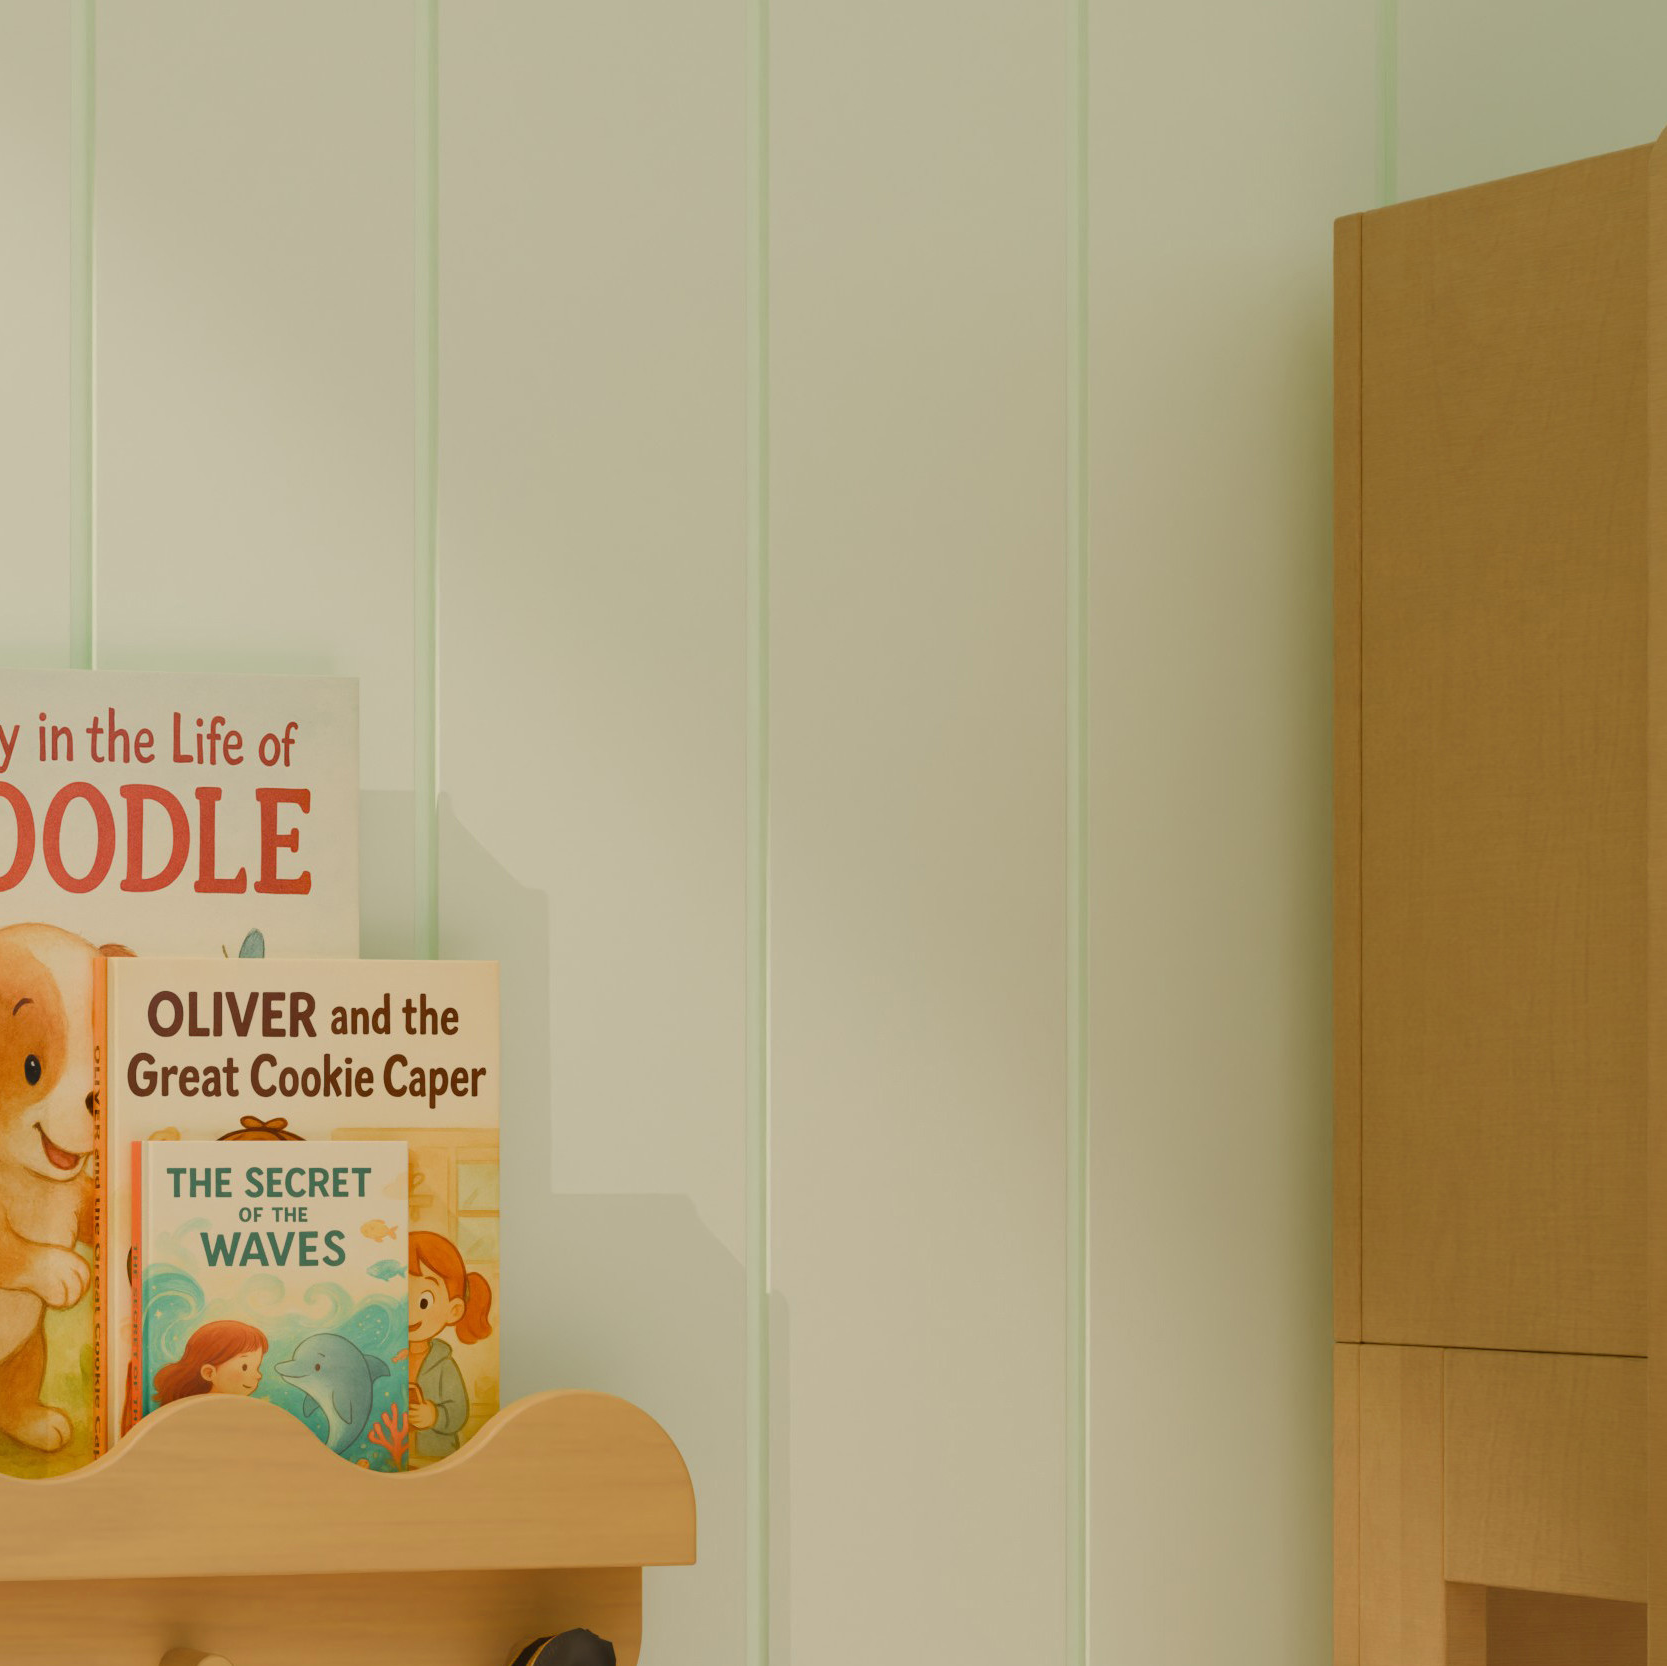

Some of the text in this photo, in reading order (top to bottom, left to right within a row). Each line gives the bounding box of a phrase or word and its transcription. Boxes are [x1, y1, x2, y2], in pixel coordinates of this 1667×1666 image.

[38, 712, 75, 763] in
[86, 709, 158, 765] the
[173, 712, 246, 766] Life
[258, 721, 300, 769] of
[147, 991, 460, 1039] OLIVER and the
[127, 1052, 488, 1111] Great Cookie Caper
[166, 1166, 373, 1201] THE SECRET
[238, 1206, 310, 1225] OF THE
[199, 1229, 349, 1270] WAVES
